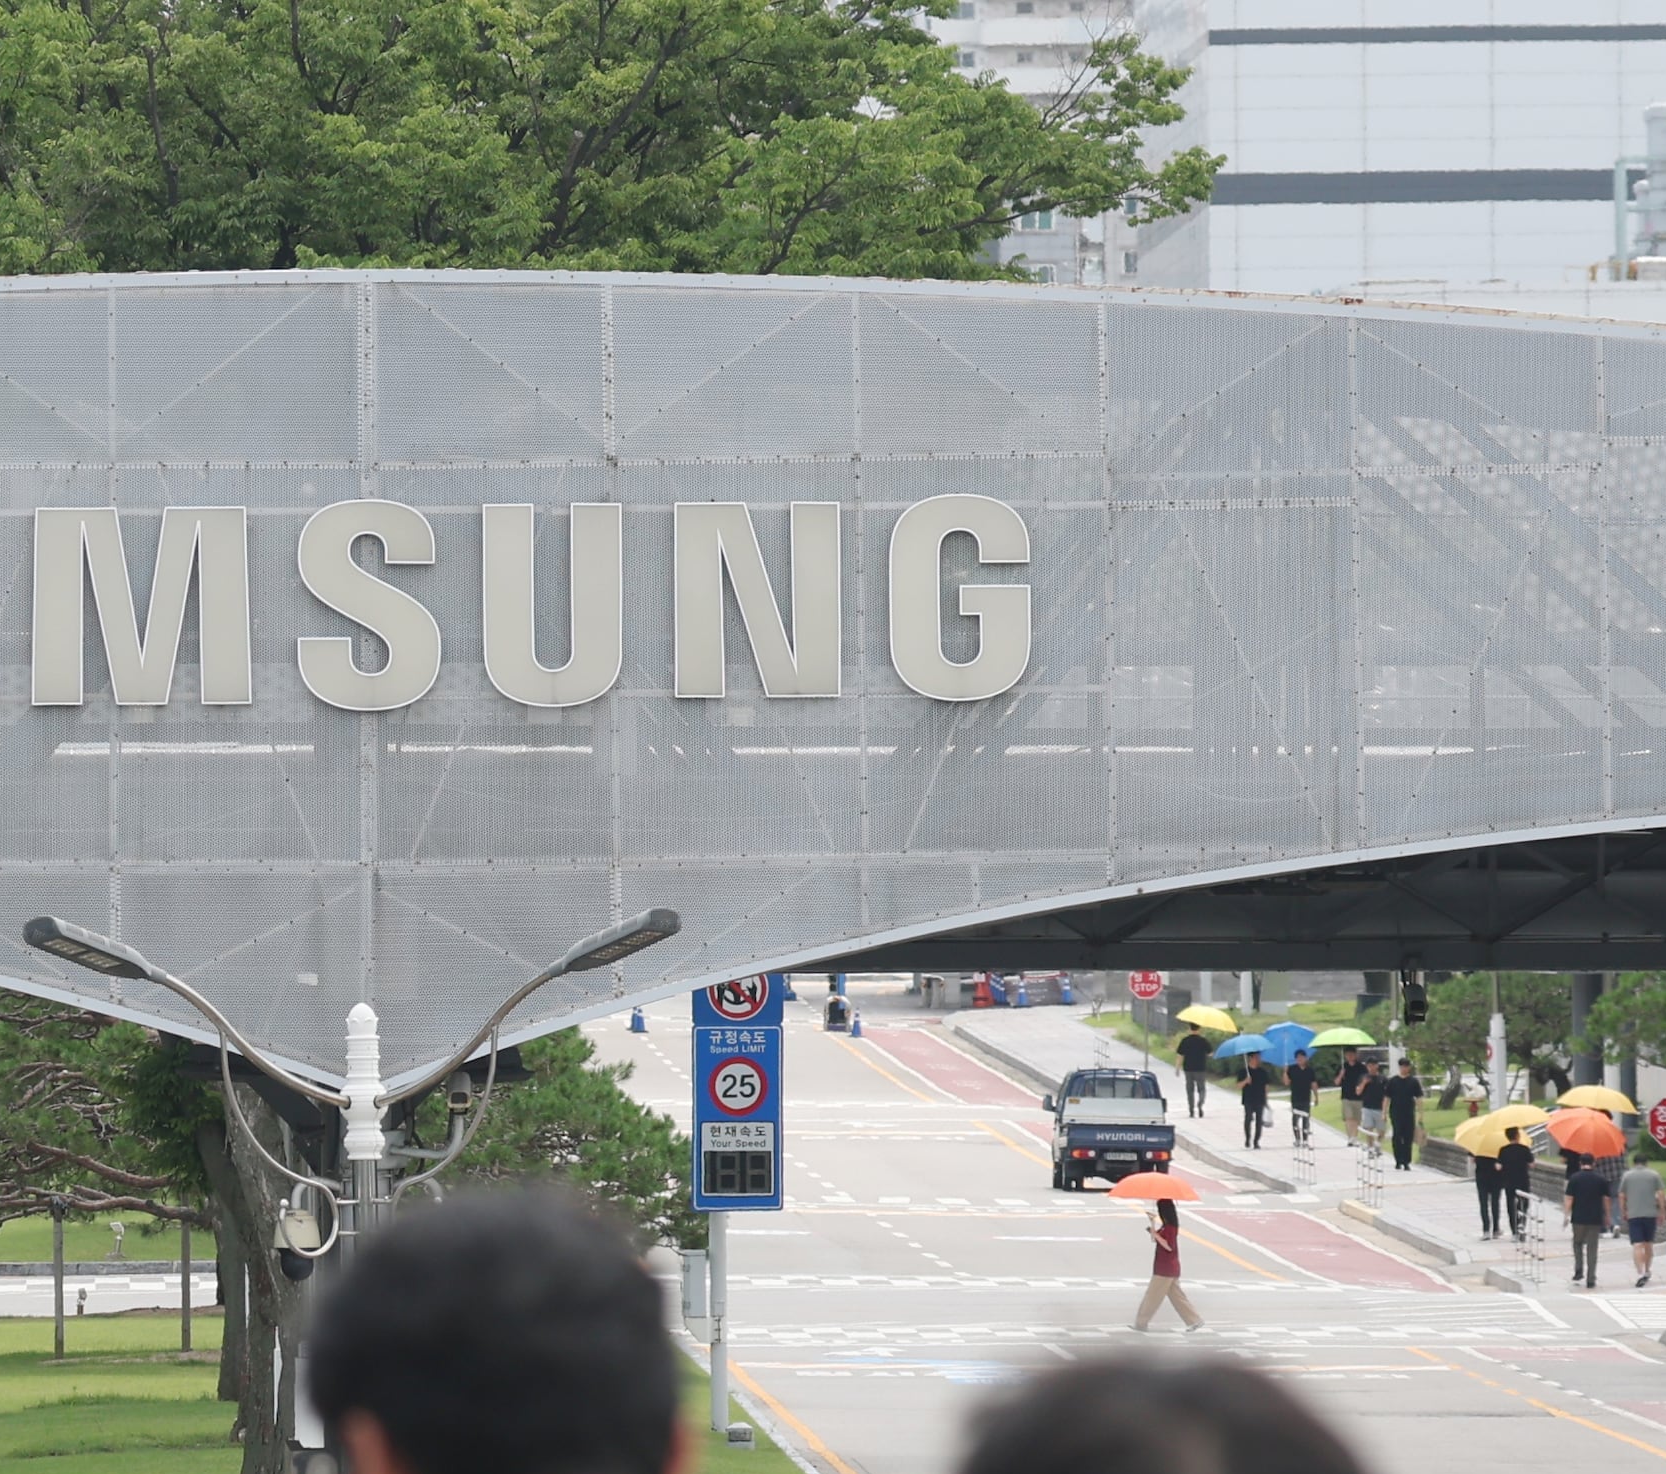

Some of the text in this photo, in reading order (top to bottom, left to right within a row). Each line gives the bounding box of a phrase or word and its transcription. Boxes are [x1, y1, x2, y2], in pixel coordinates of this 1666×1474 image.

[1133, 983, 1159, 992] STOP
[709, 1030, 766, 1045] 규정속도
[709, 1045, 739, 1054] Speed
[722, 1074, 756, 1098] 25
[1096, 1132, 1145, 1142] HYUNDAI
[710, 1139, 766, 1149] Your Speed
